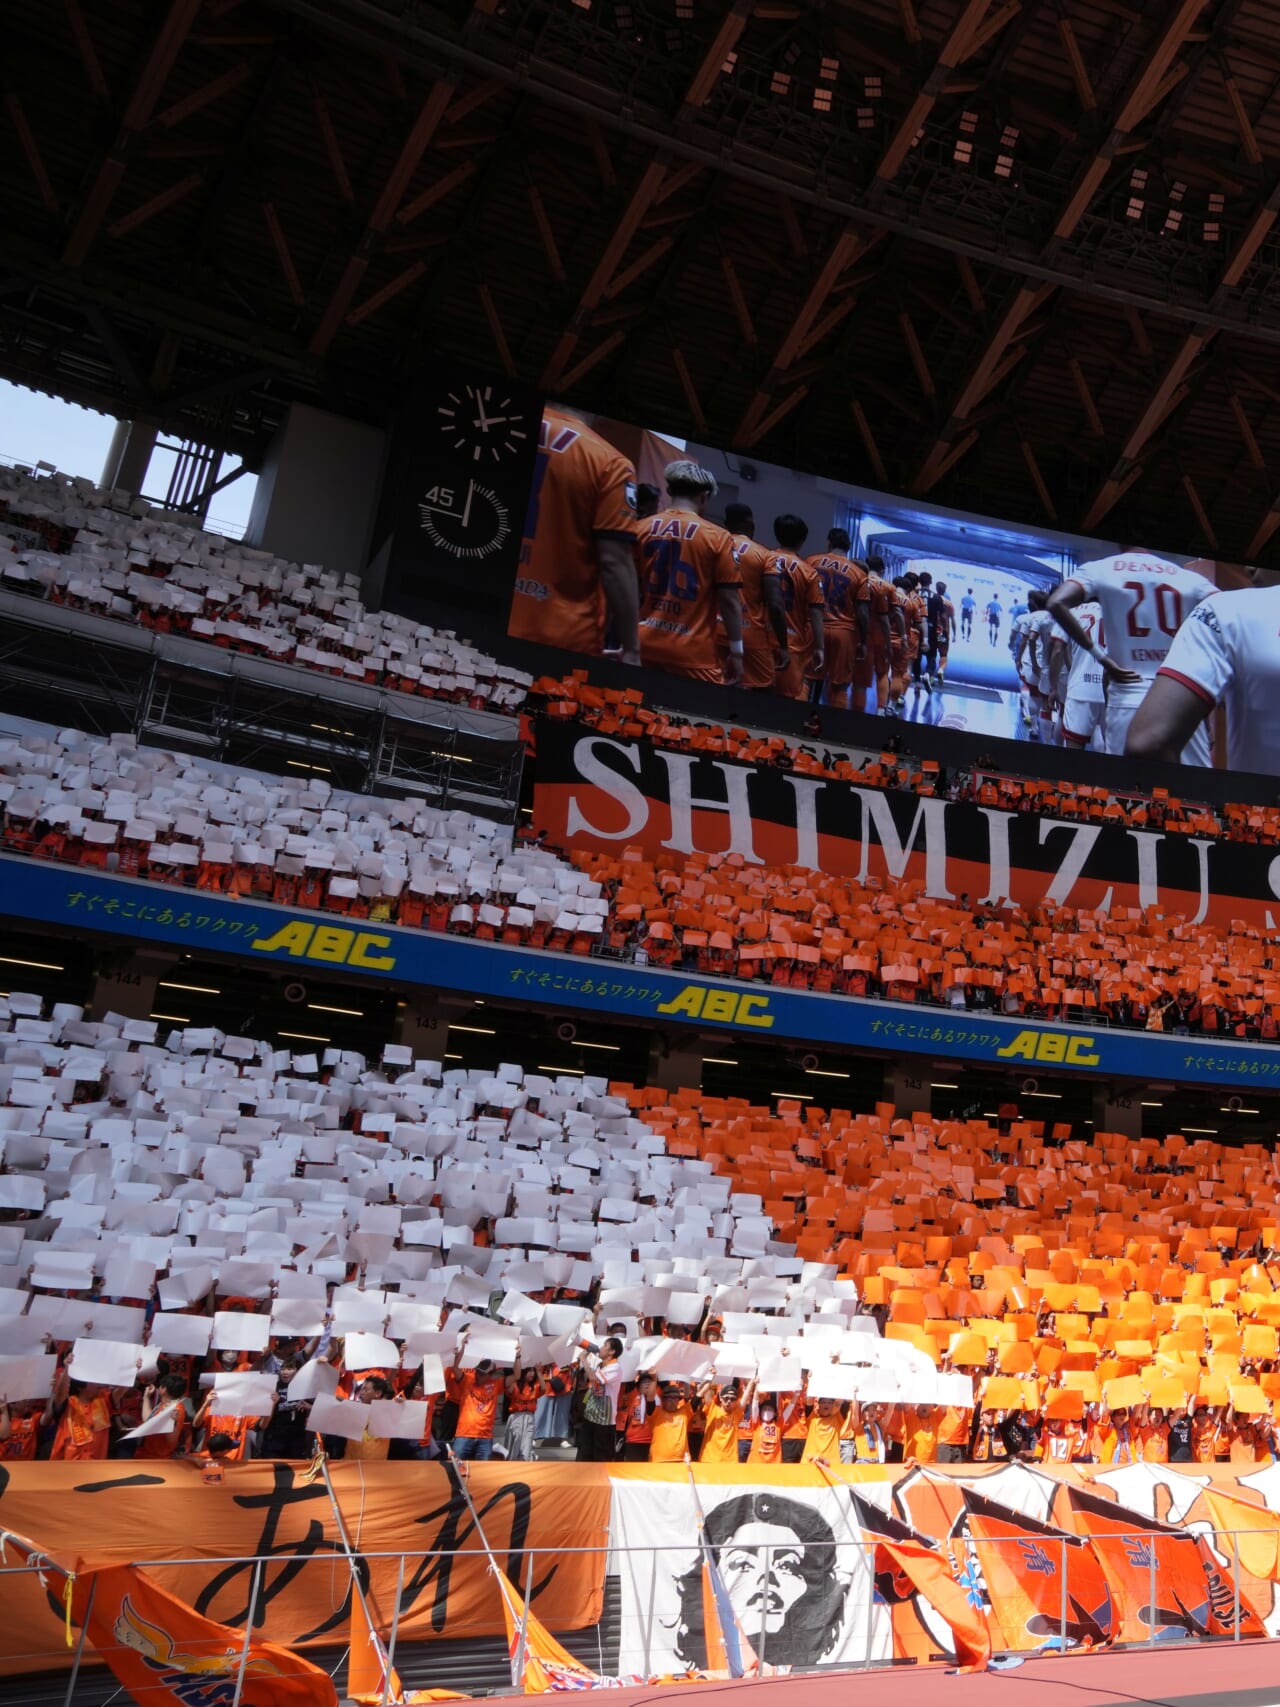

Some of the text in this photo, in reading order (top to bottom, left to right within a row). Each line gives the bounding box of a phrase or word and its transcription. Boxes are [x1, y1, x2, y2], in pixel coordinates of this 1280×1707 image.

[425, 485, 455, 508] 45
[649, 518, 700, 541] IAI
[820, 557, 849, 573] IAI
[1113, 560, 1178, 576] DENSO
[1123, 580, 1183, 639] 20
[566, 735, 1217, 926] SHIMIZU
[65, 890, 397, 972] すぐそこにあるワクワク ABC
[507, 967, 776, 1029] すぐそこにあるワクワク ABC
[415, 1016, 439, 1032] 143
[870, 1019, 1101, 1067] すぐそこにあるワクワク ABC
[903, 1078, 923, 1091] 143
[1049, 1437, 1067, 1458] 12
